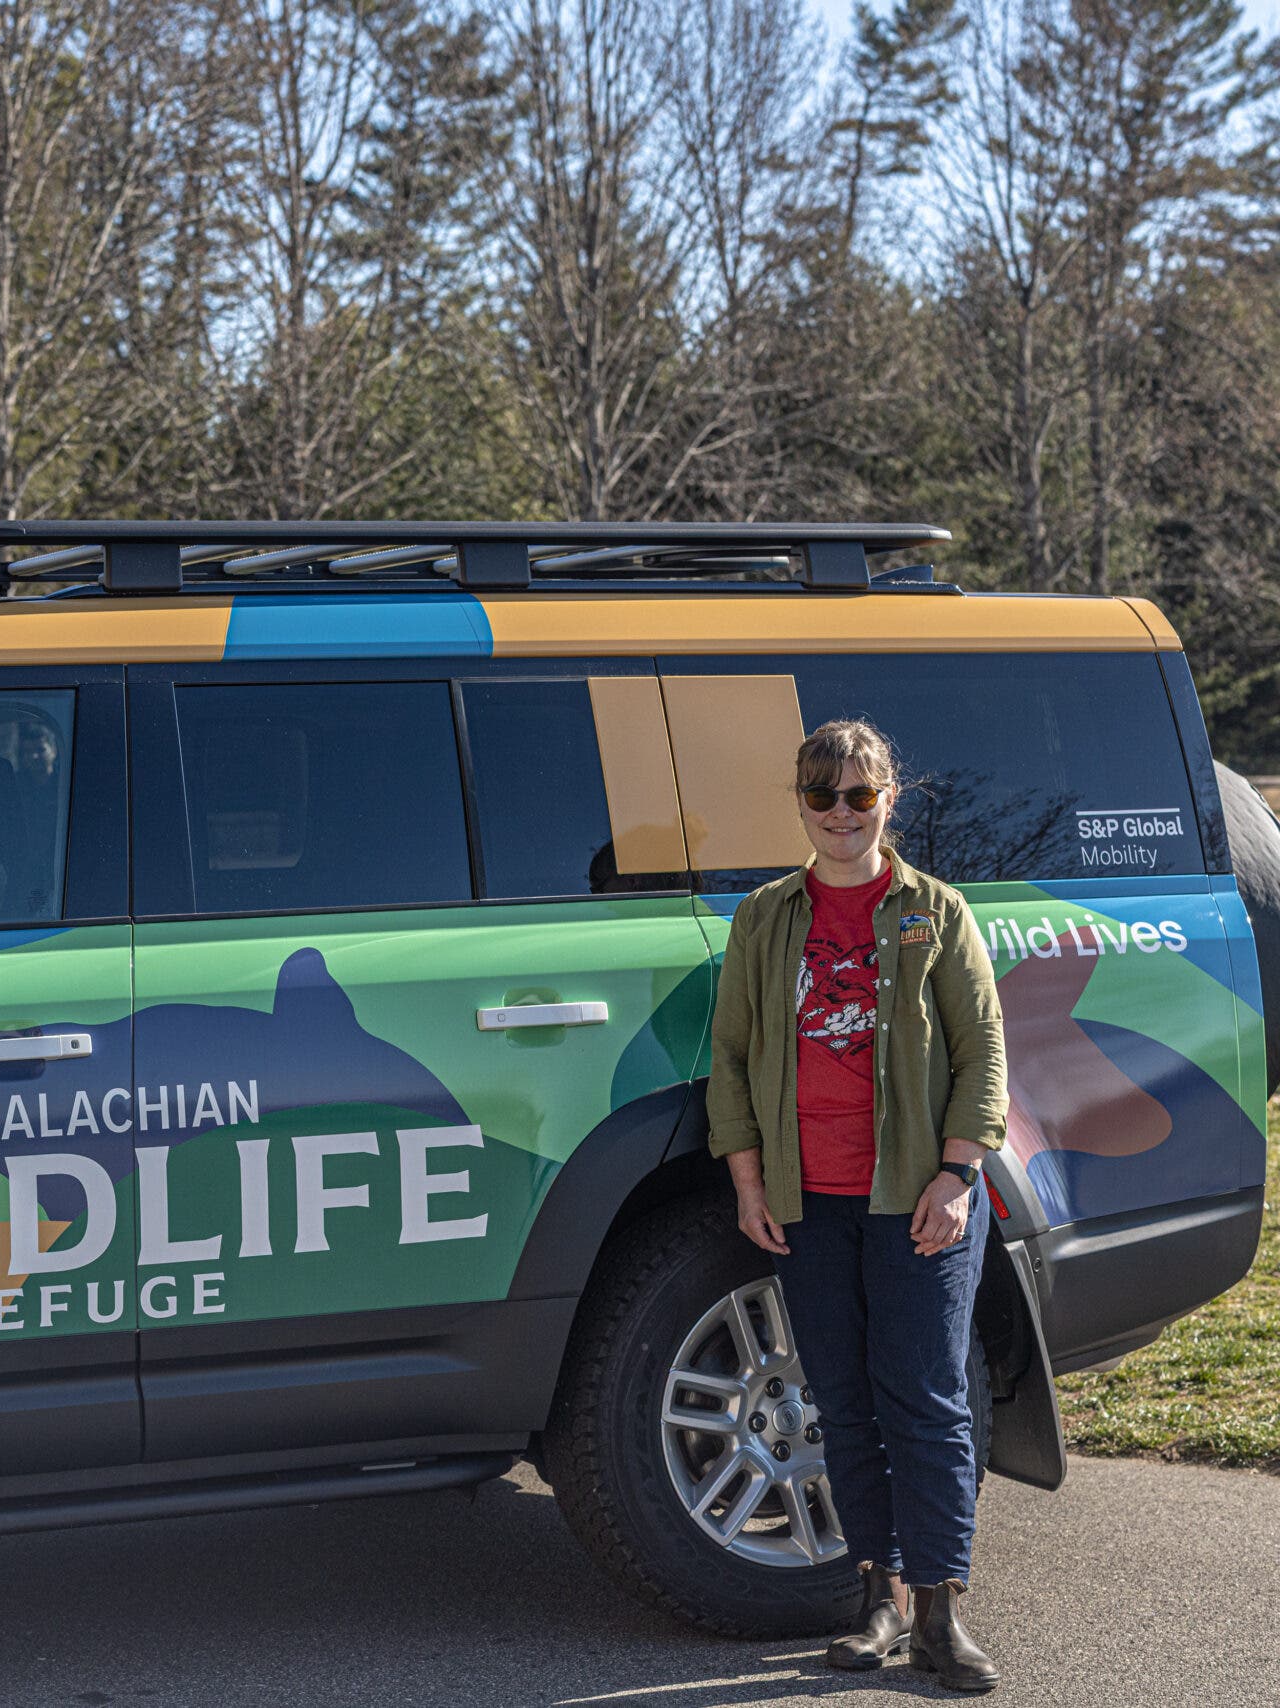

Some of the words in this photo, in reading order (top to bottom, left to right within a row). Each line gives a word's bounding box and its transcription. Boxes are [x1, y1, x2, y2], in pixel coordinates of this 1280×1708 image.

[1078, 818, 1119, 839] S&P
[1123, 815, 1184, 837] Global
[1081, 844, 1158, 869] Mobility
[1064, 913, 1188, 957] Lives
